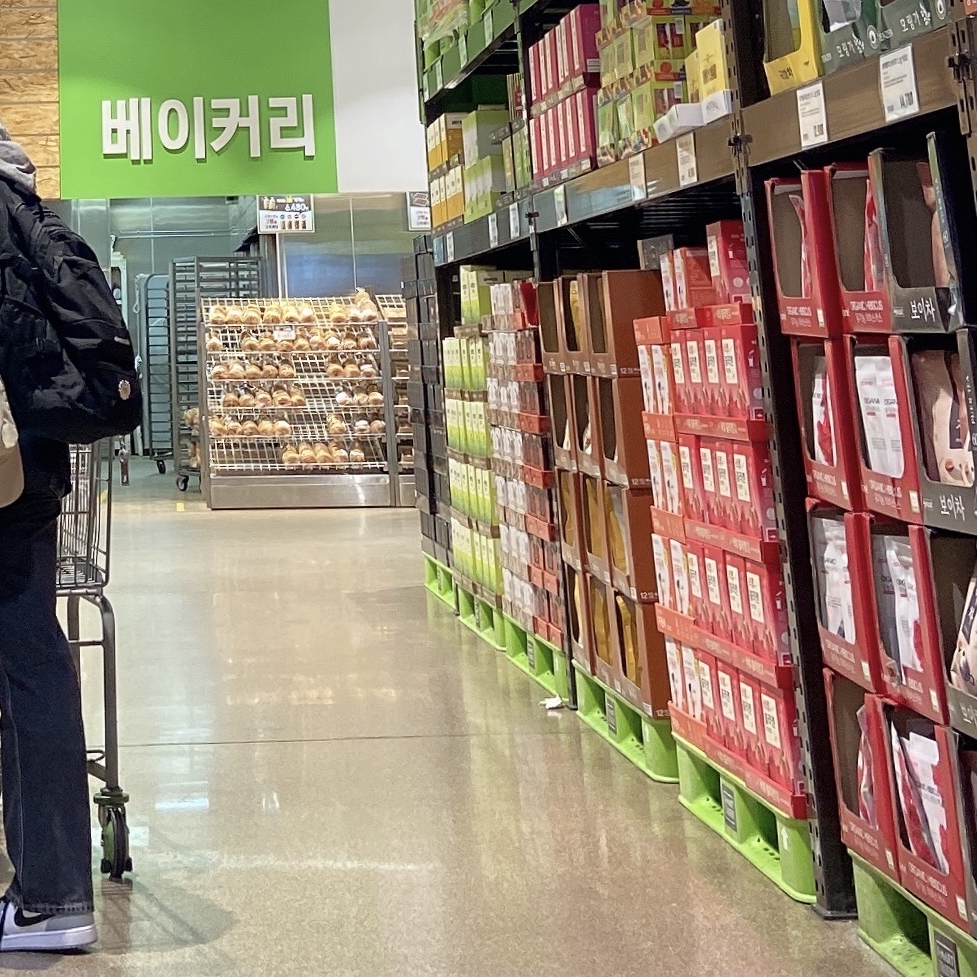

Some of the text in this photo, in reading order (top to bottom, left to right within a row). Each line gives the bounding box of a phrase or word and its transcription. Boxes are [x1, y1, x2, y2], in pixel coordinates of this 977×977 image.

[102, 94, 315, 161] 베이커리
[910, 297, 937, 323] 보이차
[939, 493, 966, 522] 보이차
